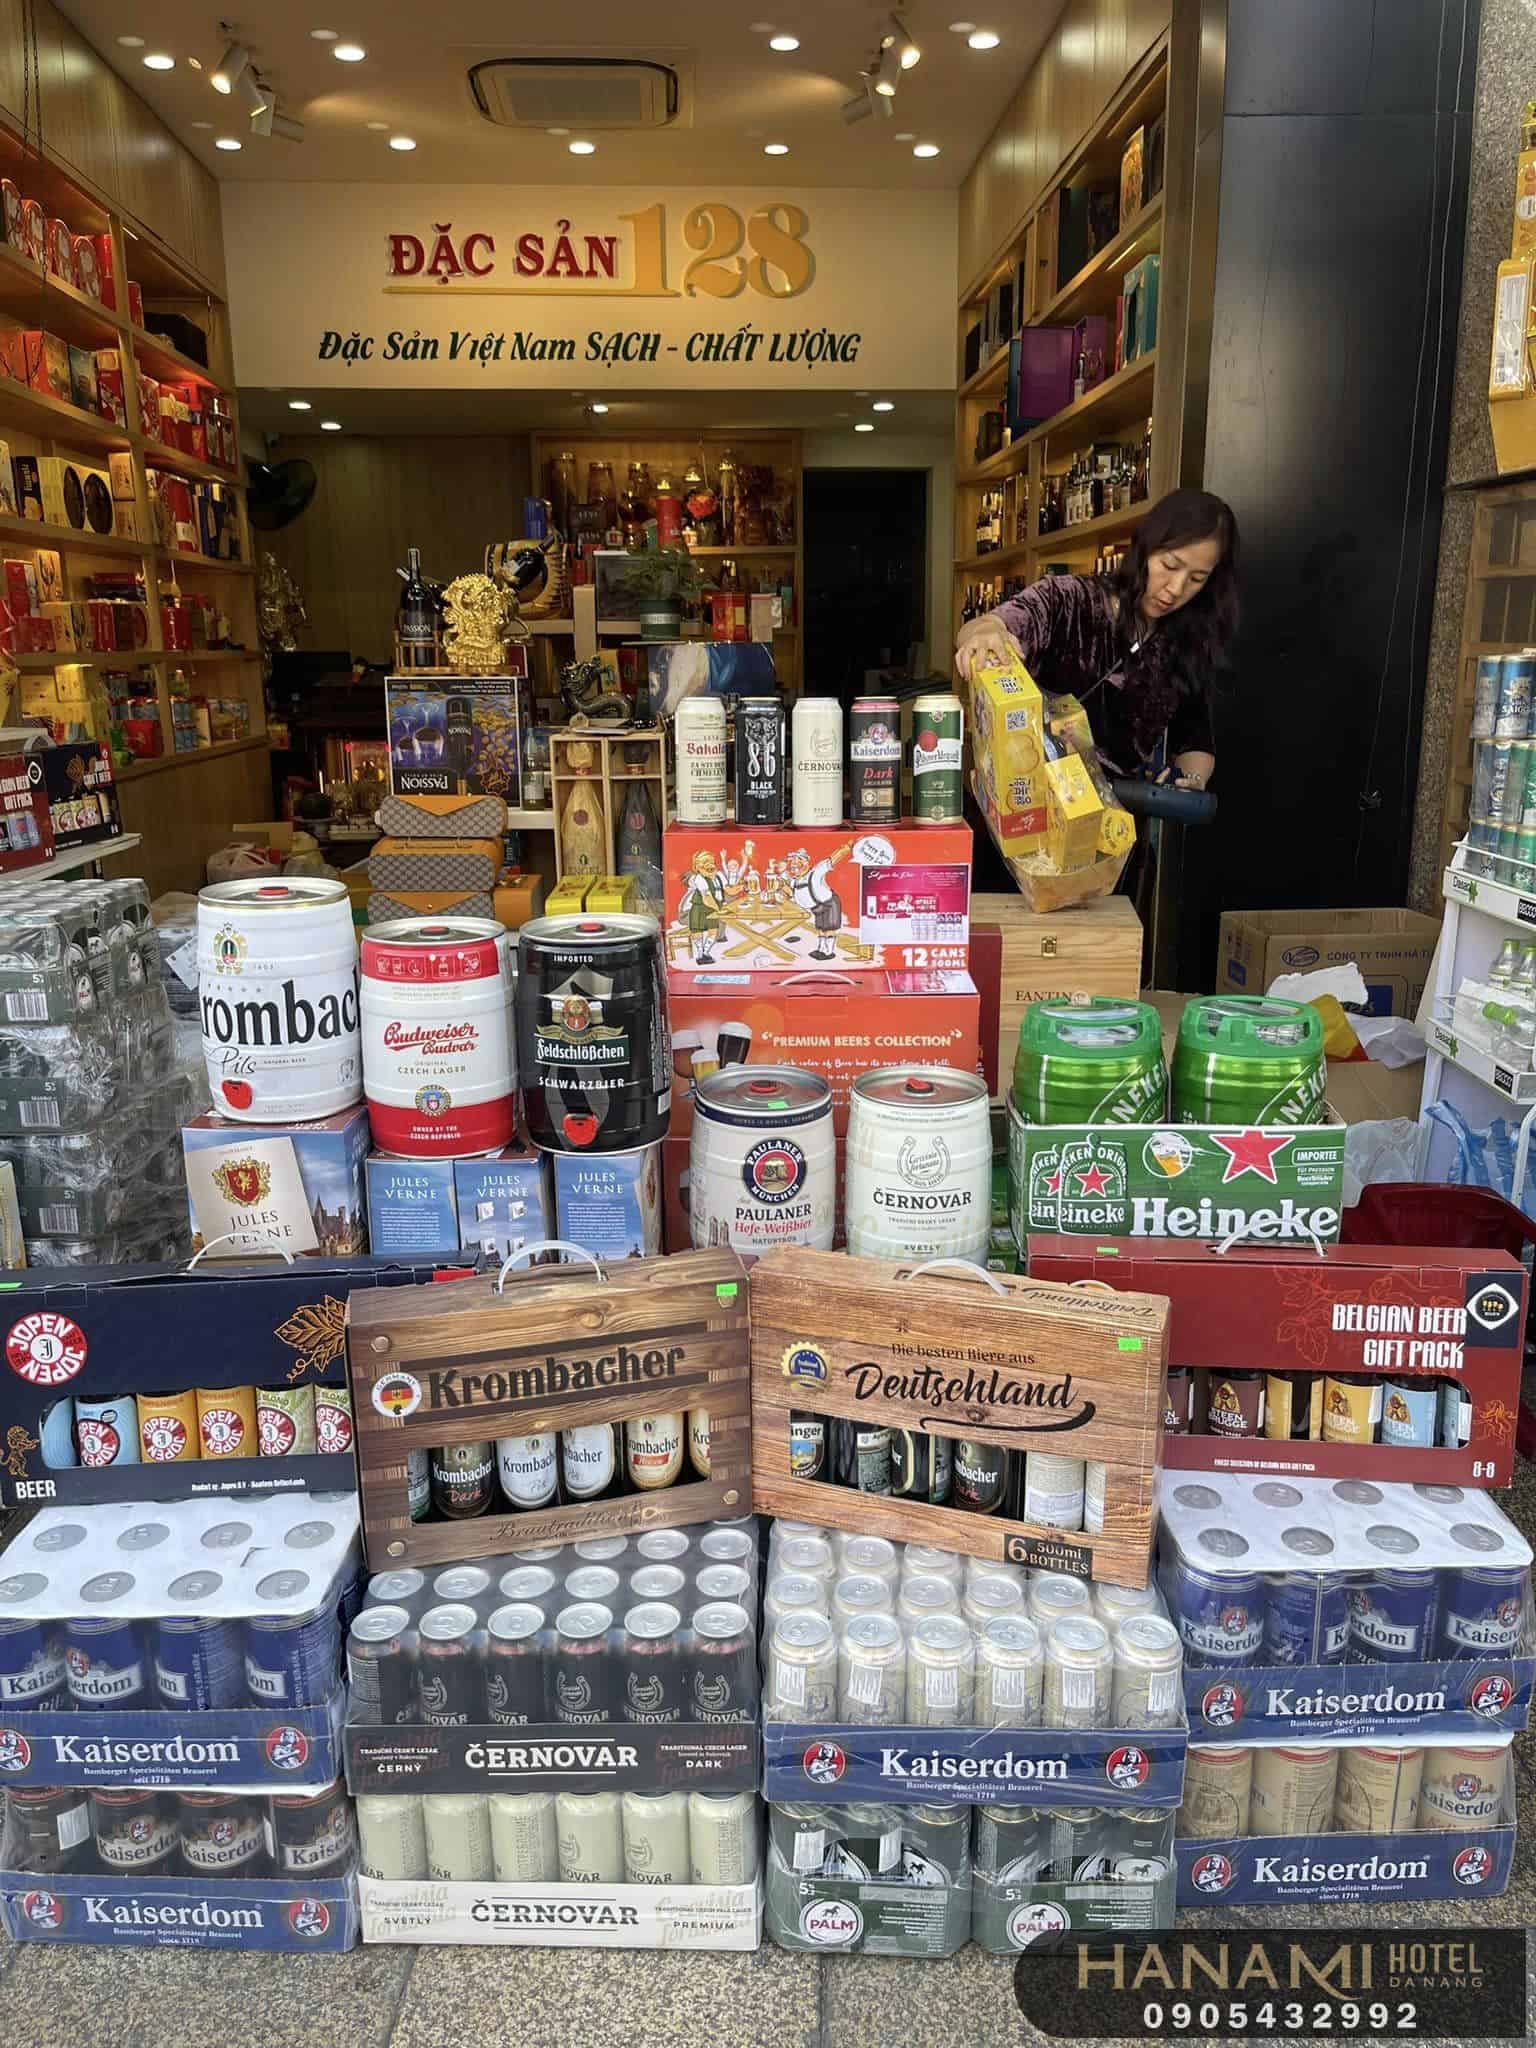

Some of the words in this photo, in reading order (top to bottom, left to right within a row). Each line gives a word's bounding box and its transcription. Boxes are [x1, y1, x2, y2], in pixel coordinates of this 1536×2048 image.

[388, 223, 496, 284] ĐẶC
[513, 219, 620, 279] SẢN
[619, 201, 816, 298] 128
[318, 331, 375, 367] Đặc
[383, 330, 438, 361] Sản
[448, 331, 506, 367] Việt
[511, 332, 576, 361] Nam
[584, 332, 660, 369] SẠCH
[685, 323, 763, 363] CHẤT
[769, 329, 861, 369] LƯỢNG
[401, 775, 448, 790] PASSION
[863, 767, 894, 779] Dark
[750, 781, 773, 790] BLACK
[553, 954, 594, 964] IMPORTED
[902, 947, 929, 968] 12
[930, 948, 966, 958] CANS
[201, 978, 360, 1046] rombac
[834, 1035, 871, 1047] BEERS
[209, 1047, 257, 1075] Pils
[398, 1066, 429, 1075] CZECH
[433, 1065, 466, 1075] LAGER
[538, 1076, 625, 1090] SCHWARZBIER
[747, 1140, 803, 1165] PAULANER
[390, 1175, 430, 1188] JULES
[483, 1174, 521, 1186] JULES
[578, 1172, 616, 1183] JULES
[384, 1188, 437, 1200] VERNE
[476, 1187, 529, 1198] VERNE
[571, 1183, 625, 1195] VERNE
[751, 1183, 800, 1202] MÜNCHEN
[873, 1187, 972, 1210] ČERNOVAR
[230, 1210, 279, 1231] JULES
[735, 1203, 812, 1222] PAULANER
[735, 1219, 812, 1236] Hefe-Weißbier
[1332, 1303, 1413, 1334] BELGIAN
[1418, 1306, 1468, 1336] BEER
[9, 1313, 75, 1351] JOPEN
[891, 1343, 914, 1357] Die
[917, 1345, 964, 1361] besten
[967, 1348, 1004, 1364] Biere
[1008, 1353, 1036, 1365] aus
[1363, 1338, 1404, 1367] GIFT
[1408, 1340, 1465, 1369] PACK
[20, 1346, 85, 1383] JOPEN
[428, 1346, 686, 1409] Krombacher
[845, 1361, 1082, 1412] Deutschland
[143, 1417, 177, 1439] JOPEN
[202, 1409, 239, 1433] JOPEN
[15, 1480, 57, 1500] BEER
[448, 1489, 483, 1503] Dark
[1007, 1537, 1029, 1563] 6
[1030, 1553, 1089, 1575] BOTTLES
[1266, 1685, 1446, 1716] Kaiserdom
[1290, 1717, 1332, 1728] Bamberger
[1387, 1715, 1421, 1725] Brauerei
[51, 1735, 240, 1763] Kaiserdom
[465, 1743, 639, 1769] ČERNOVAR
[84, 1767, 128, 1776] Bamberger
[182, 1767, 217, 1775] Brauerei
[377, 1762, 422, 1773] ČERNÝ
[686, 1760, 722, 1769] DARK
[880, 1749, 1069, 1780] Kaiserdom
[1253, 1858, 1429, 1883] Kaiserdom
[1277, 1885, 1319, 1895] Bamberger
[1371, 1883, 1403, 1892] Brauerei
[82, 1897, 265, 1928] Kaiserdom
[471, 1899, 640, 1926] ČERNOVAR
[673, 1920, 735, 1930] PREMIUM
[810, 1919, 855, 1930] PALM
[1016, 1920, 1062, 1934] PALM
